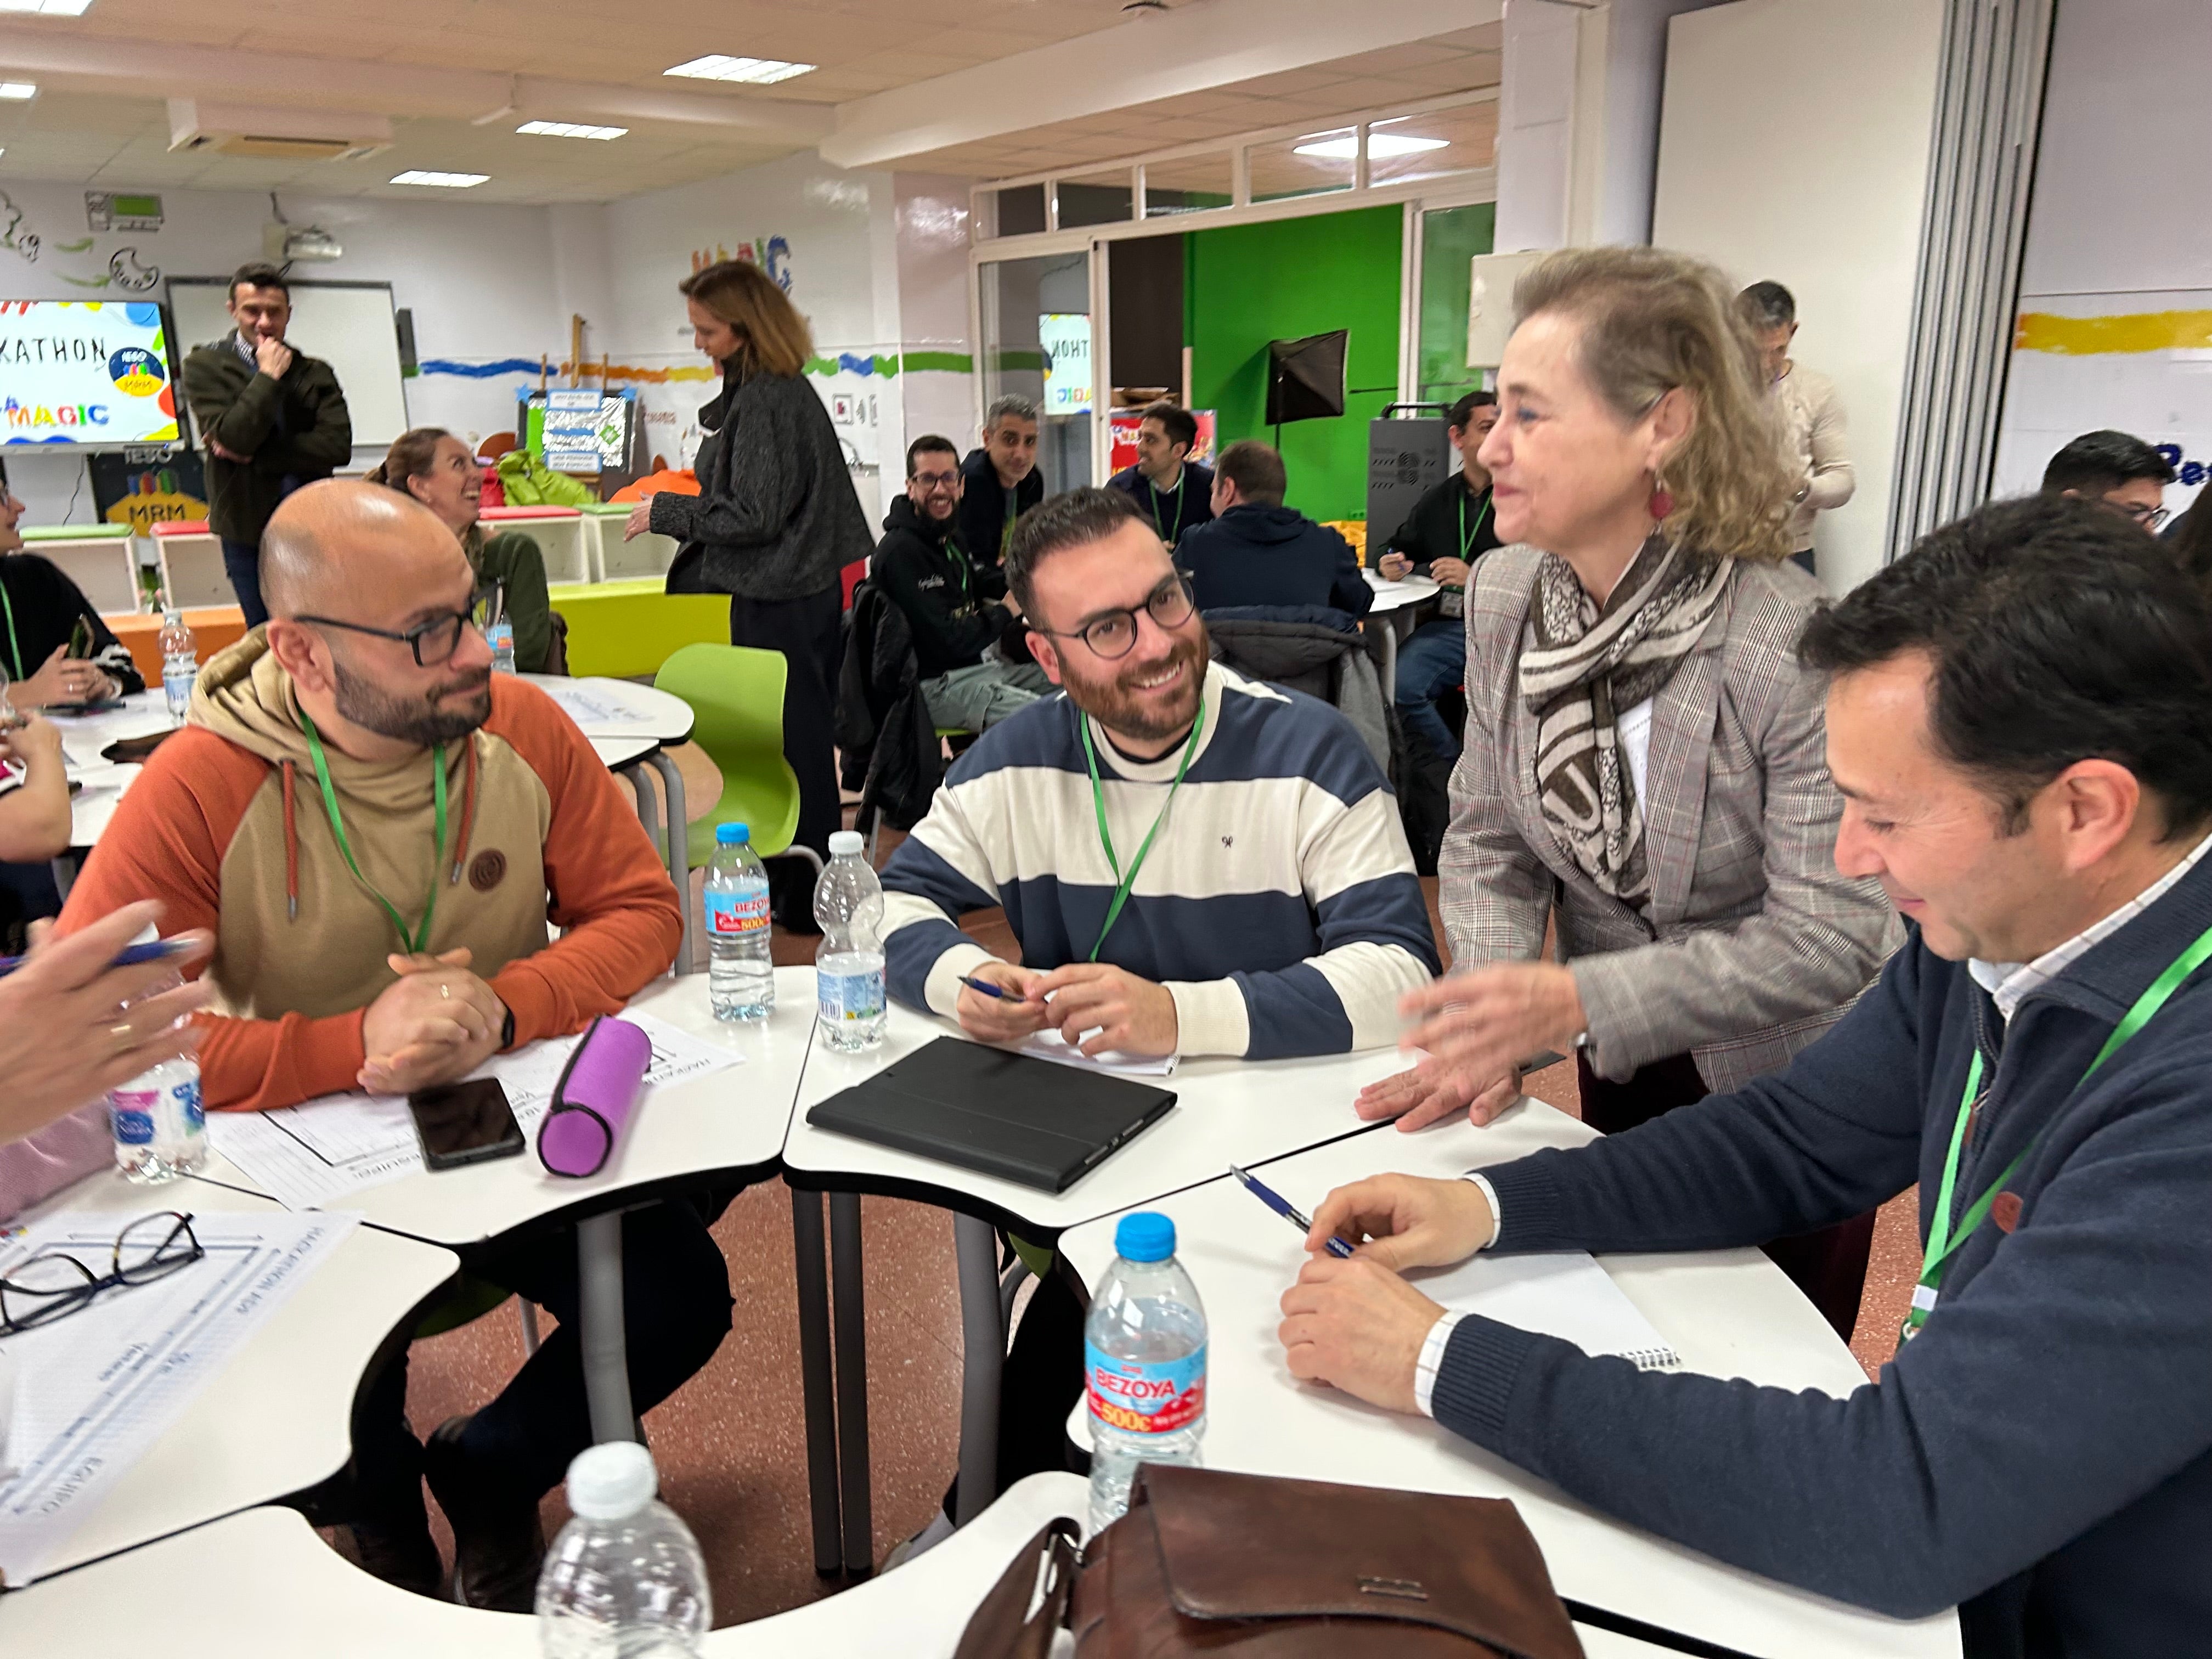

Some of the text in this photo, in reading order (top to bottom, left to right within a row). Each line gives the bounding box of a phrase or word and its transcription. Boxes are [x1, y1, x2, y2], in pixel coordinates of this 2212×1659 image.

[8, 404, 109, 428] MAGIC
[128, 503, 185, 523] MRM
[1096, 1367, 1176, 1398] BEZOYA
